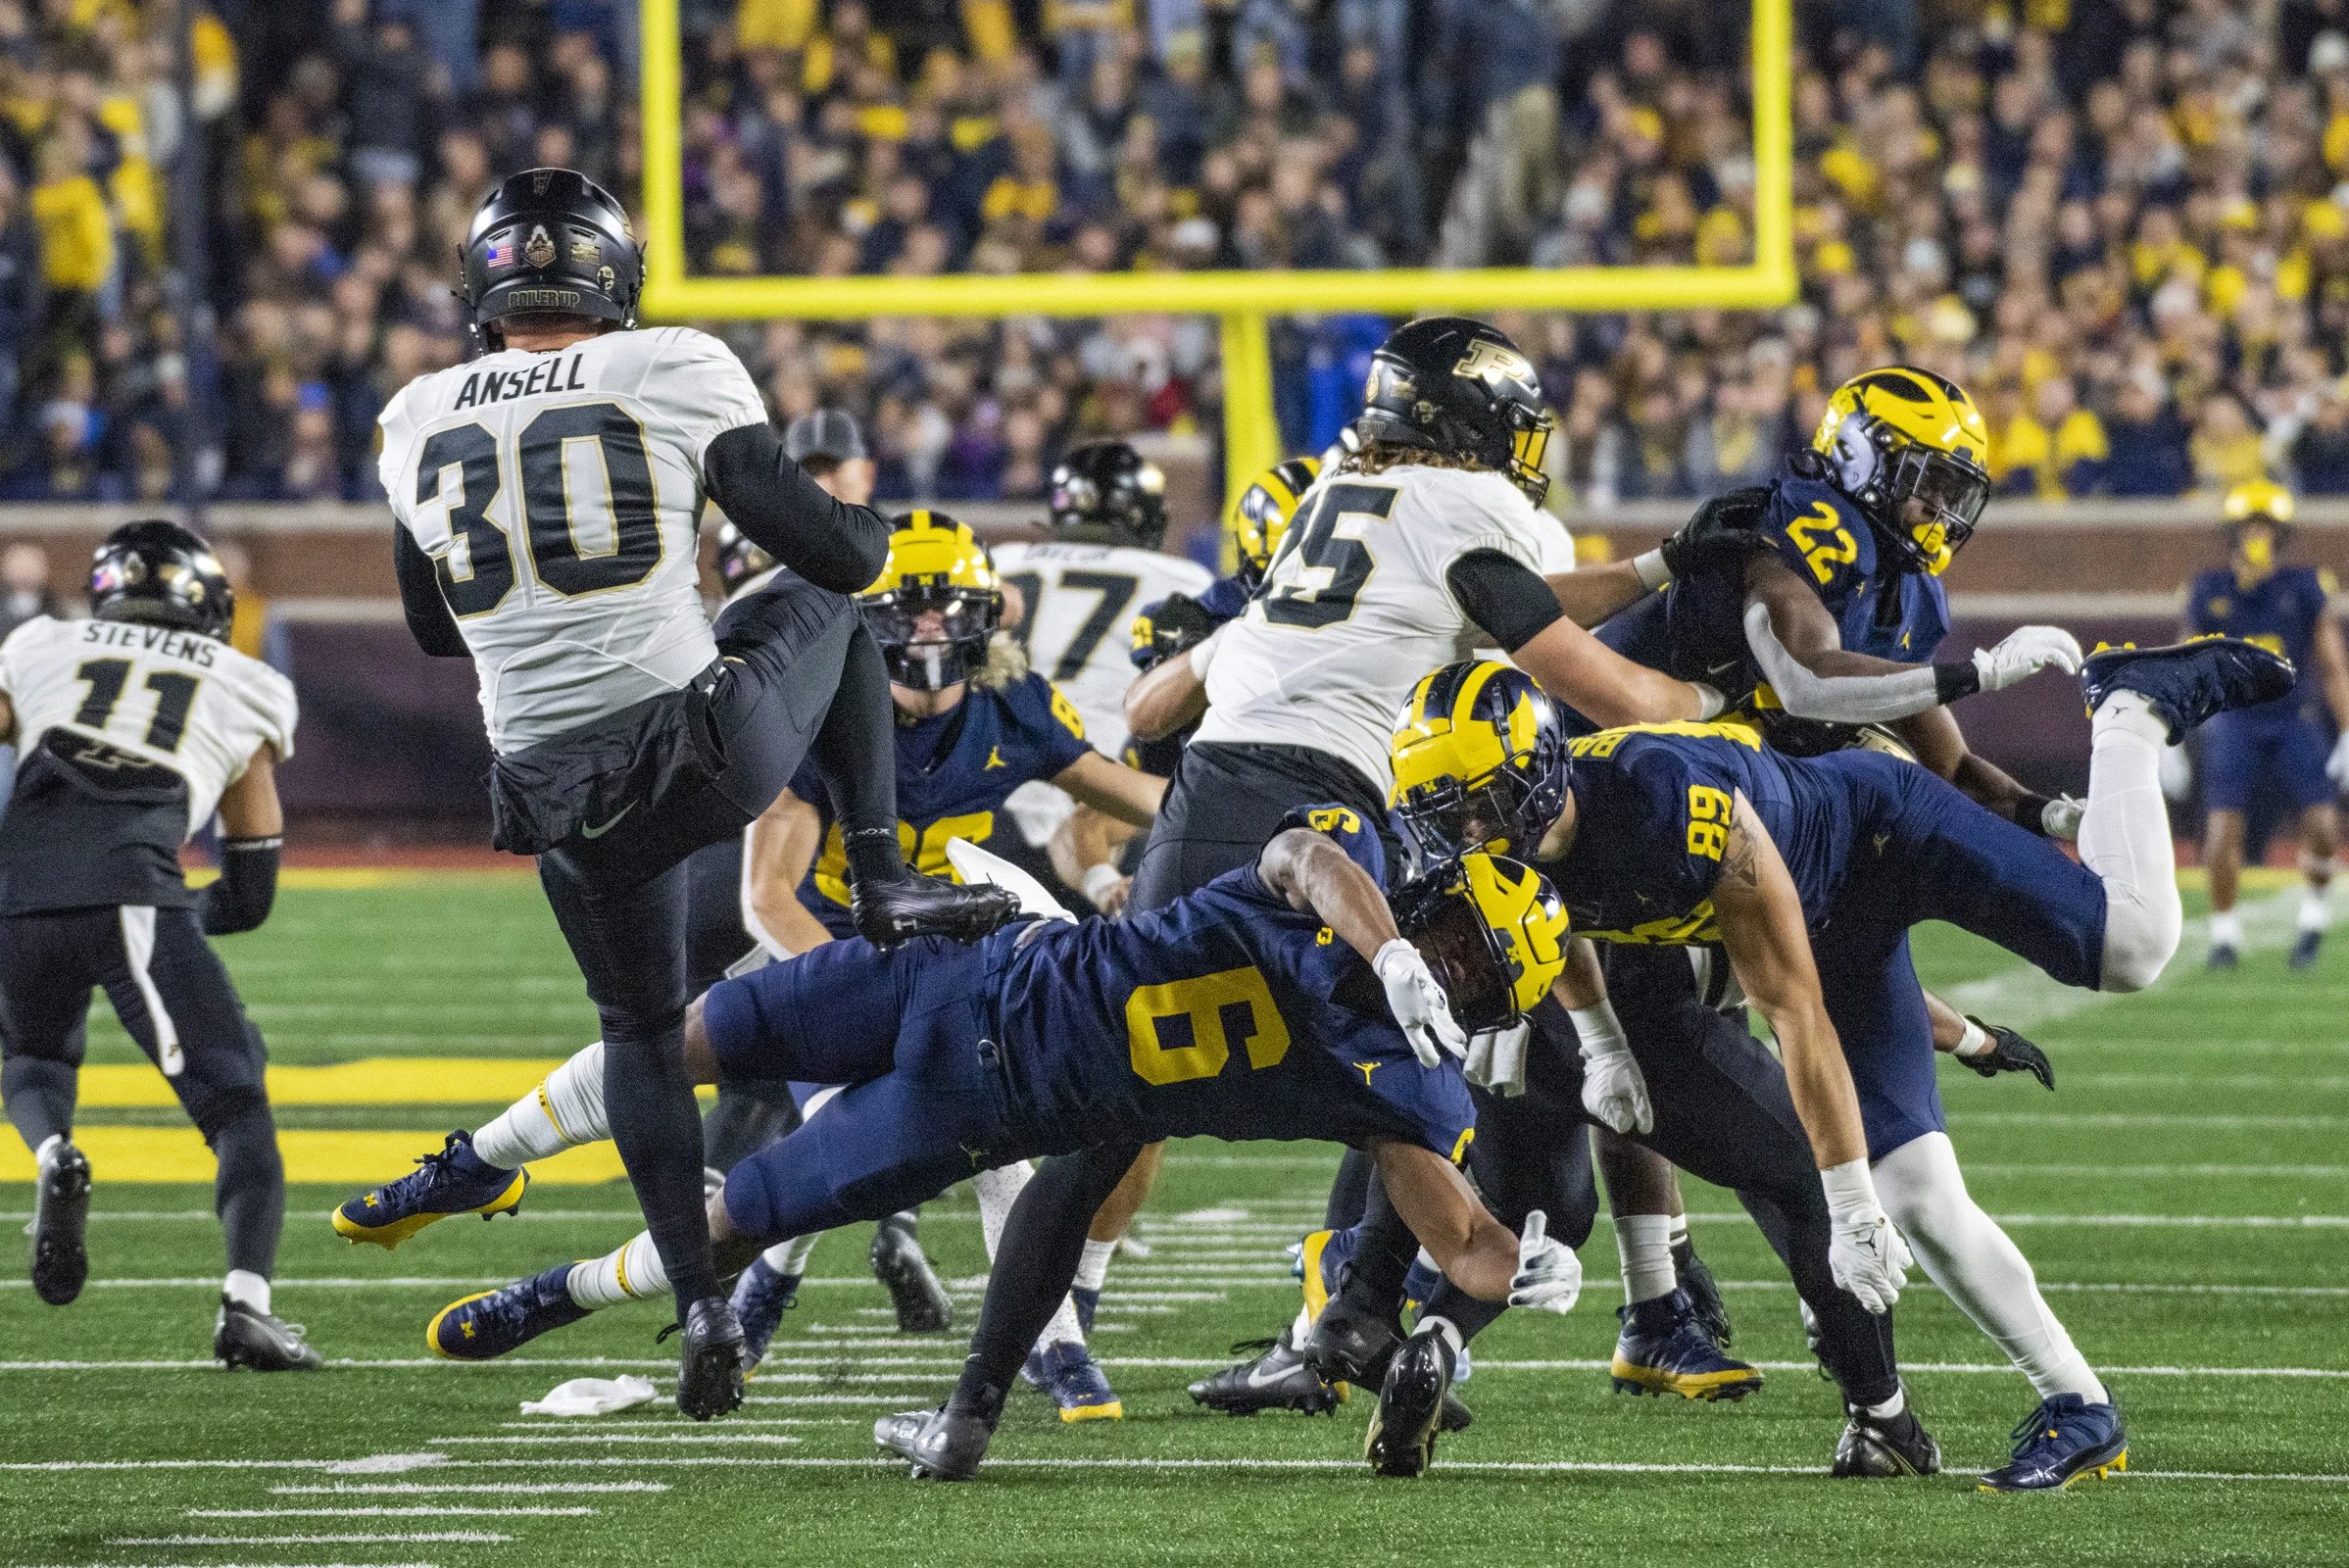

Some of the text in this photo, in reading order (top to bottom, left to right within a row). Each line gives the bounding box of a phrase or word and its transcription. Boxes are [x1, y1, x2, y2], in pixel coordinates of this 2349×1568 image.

[508, 289, 580, 308] BOILER UP
[454, 353, 585, 411] ANSELL
[415, 399, 665, 620] 30
[1786, 501, 1858, 585] 22
[83, 622, 218, 669] STEVENS
[73, 657, 202, 756] 11
[1687, 784, 1733, 862] 89
[1125, 965, 1291, 1087] 6
